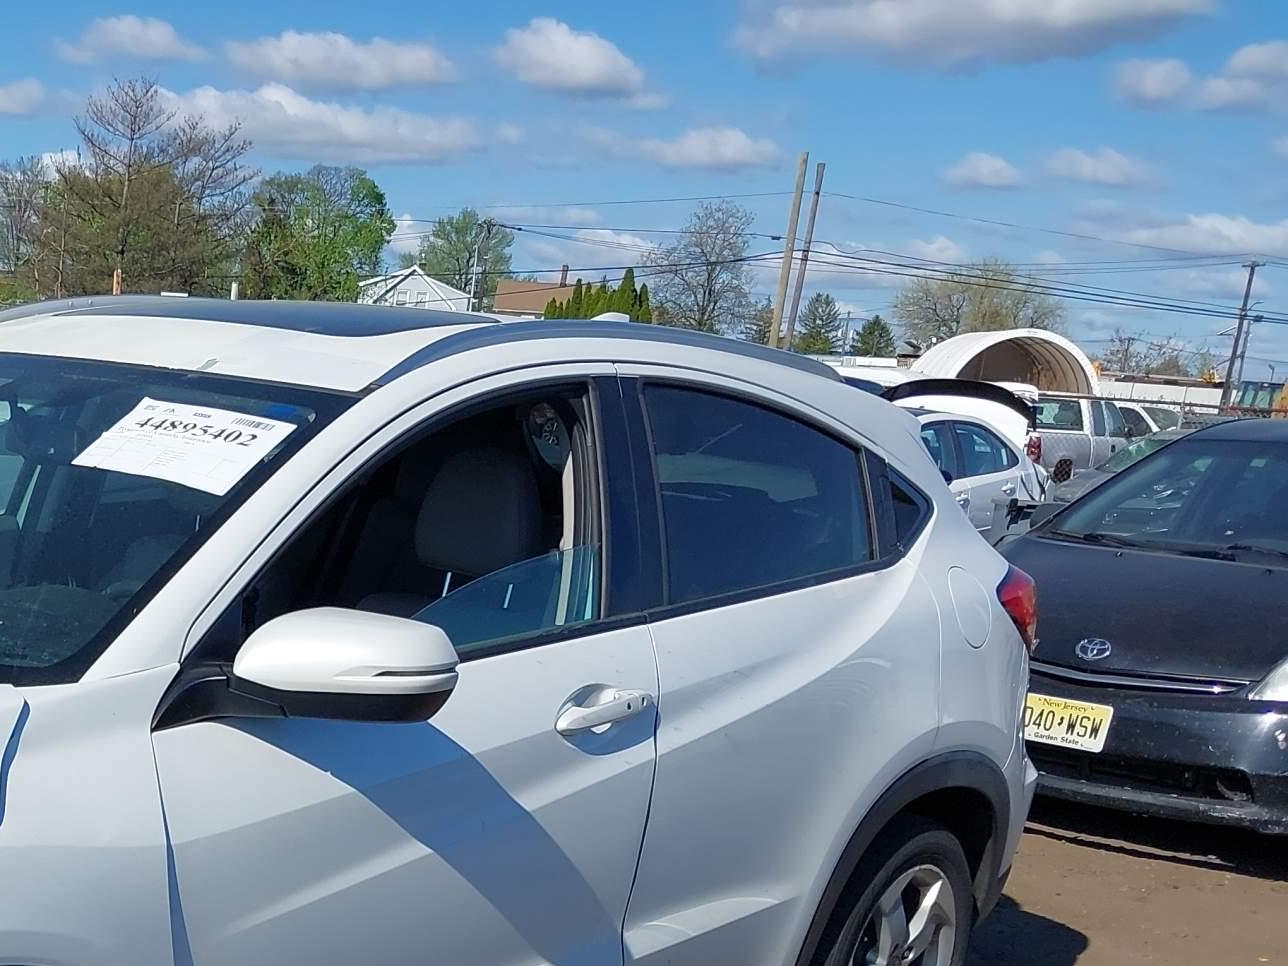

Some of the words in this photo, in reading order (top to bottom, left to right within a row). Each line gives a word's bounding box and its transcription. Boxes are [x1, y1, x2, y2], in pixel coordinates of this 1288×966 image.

[135, 416, 258, 447] 44895402
[1042, 697, 1062, 708] New
[1061, 701, 1088, 713] Jersey
[1033, 731, 1058, 742] Garden
[1059, 736, 1079, 746] State
